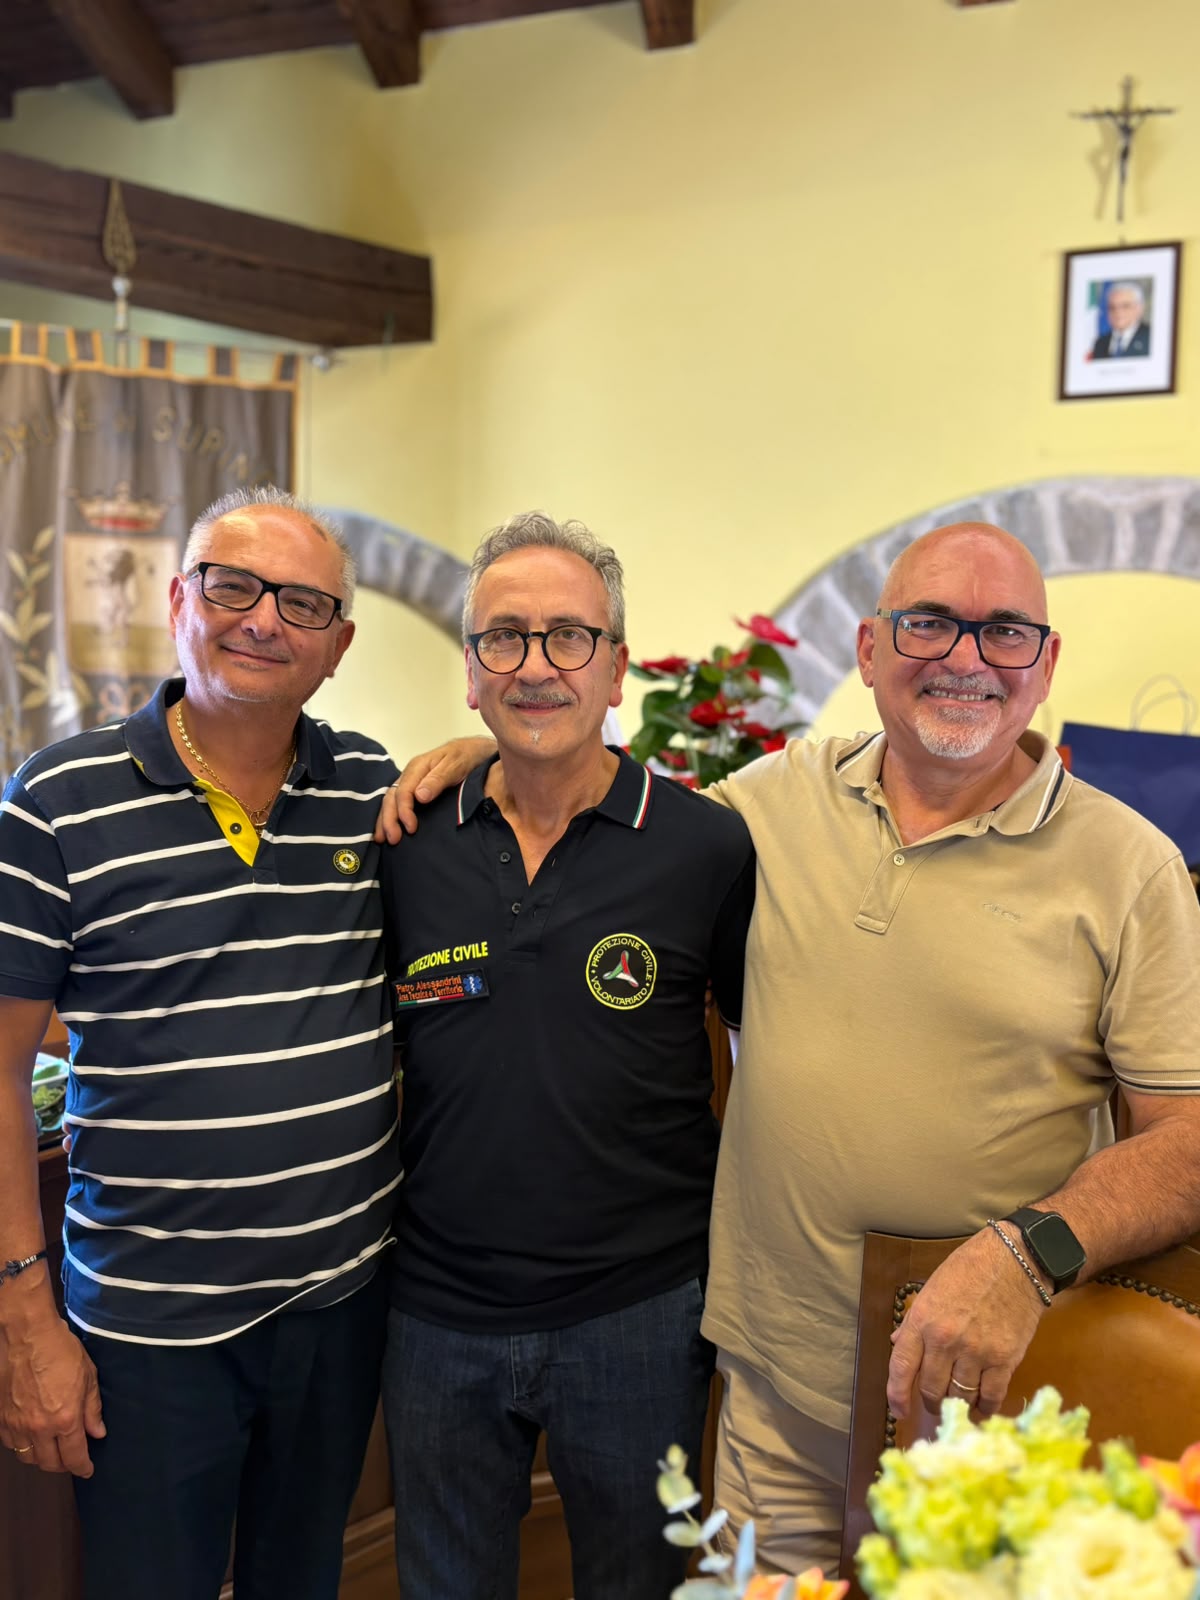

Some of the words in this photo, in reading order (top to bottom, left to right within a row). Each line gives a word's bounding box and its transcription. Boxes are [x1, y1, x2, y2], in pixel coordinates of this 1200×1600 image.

[407, 948, 450, 977] PROTEZIONE
[453, 941, 488, 962] CIVILE
[591, 937, 641, 968] PROTEZIONE
[641, 949, 653, 982] CIVILE
[396, 984, 415, 994] Pietro
[416, 975, 462, 989] Alessandrini
[434, 985, 463, 996] Territorio
[591, 975, 648, 1005] VOLONTARIATO
